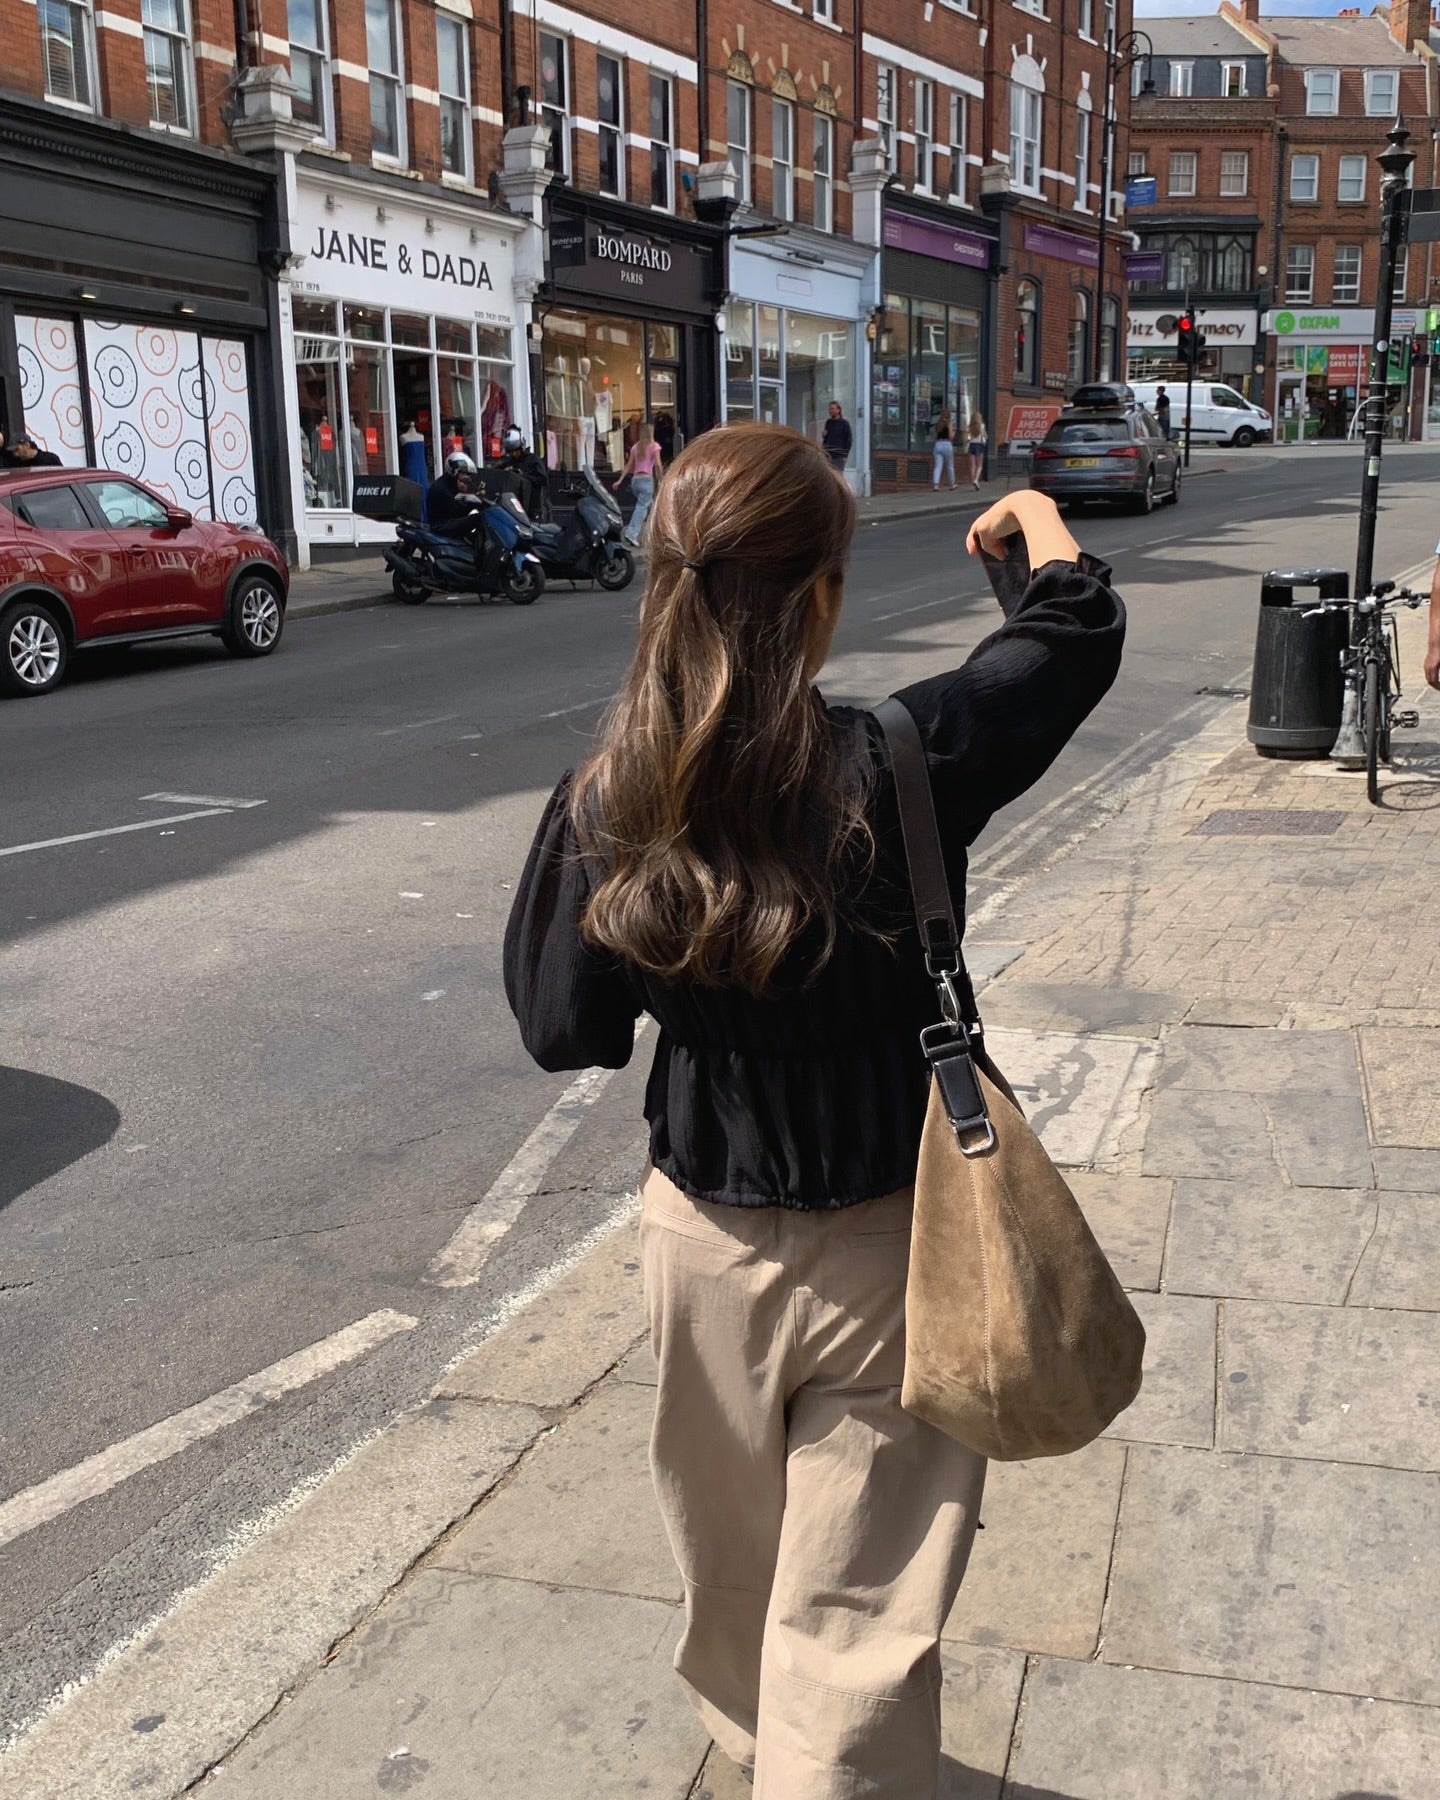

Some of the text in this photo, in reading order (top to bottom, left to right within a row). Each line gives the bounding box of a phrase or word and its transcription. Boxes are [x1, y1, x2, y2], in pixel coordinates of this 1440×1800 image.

[311, 227, 493, 291] JANE & DADA
[597, 235, 671, 271] BOMPARD
[620, 270, 643, 285] PARIS
[1300, 316, 1340, 330] OXFAM
[1329, 353, 1347, 361] GIVE
[356, 487, 391, 496] BIKE IT
